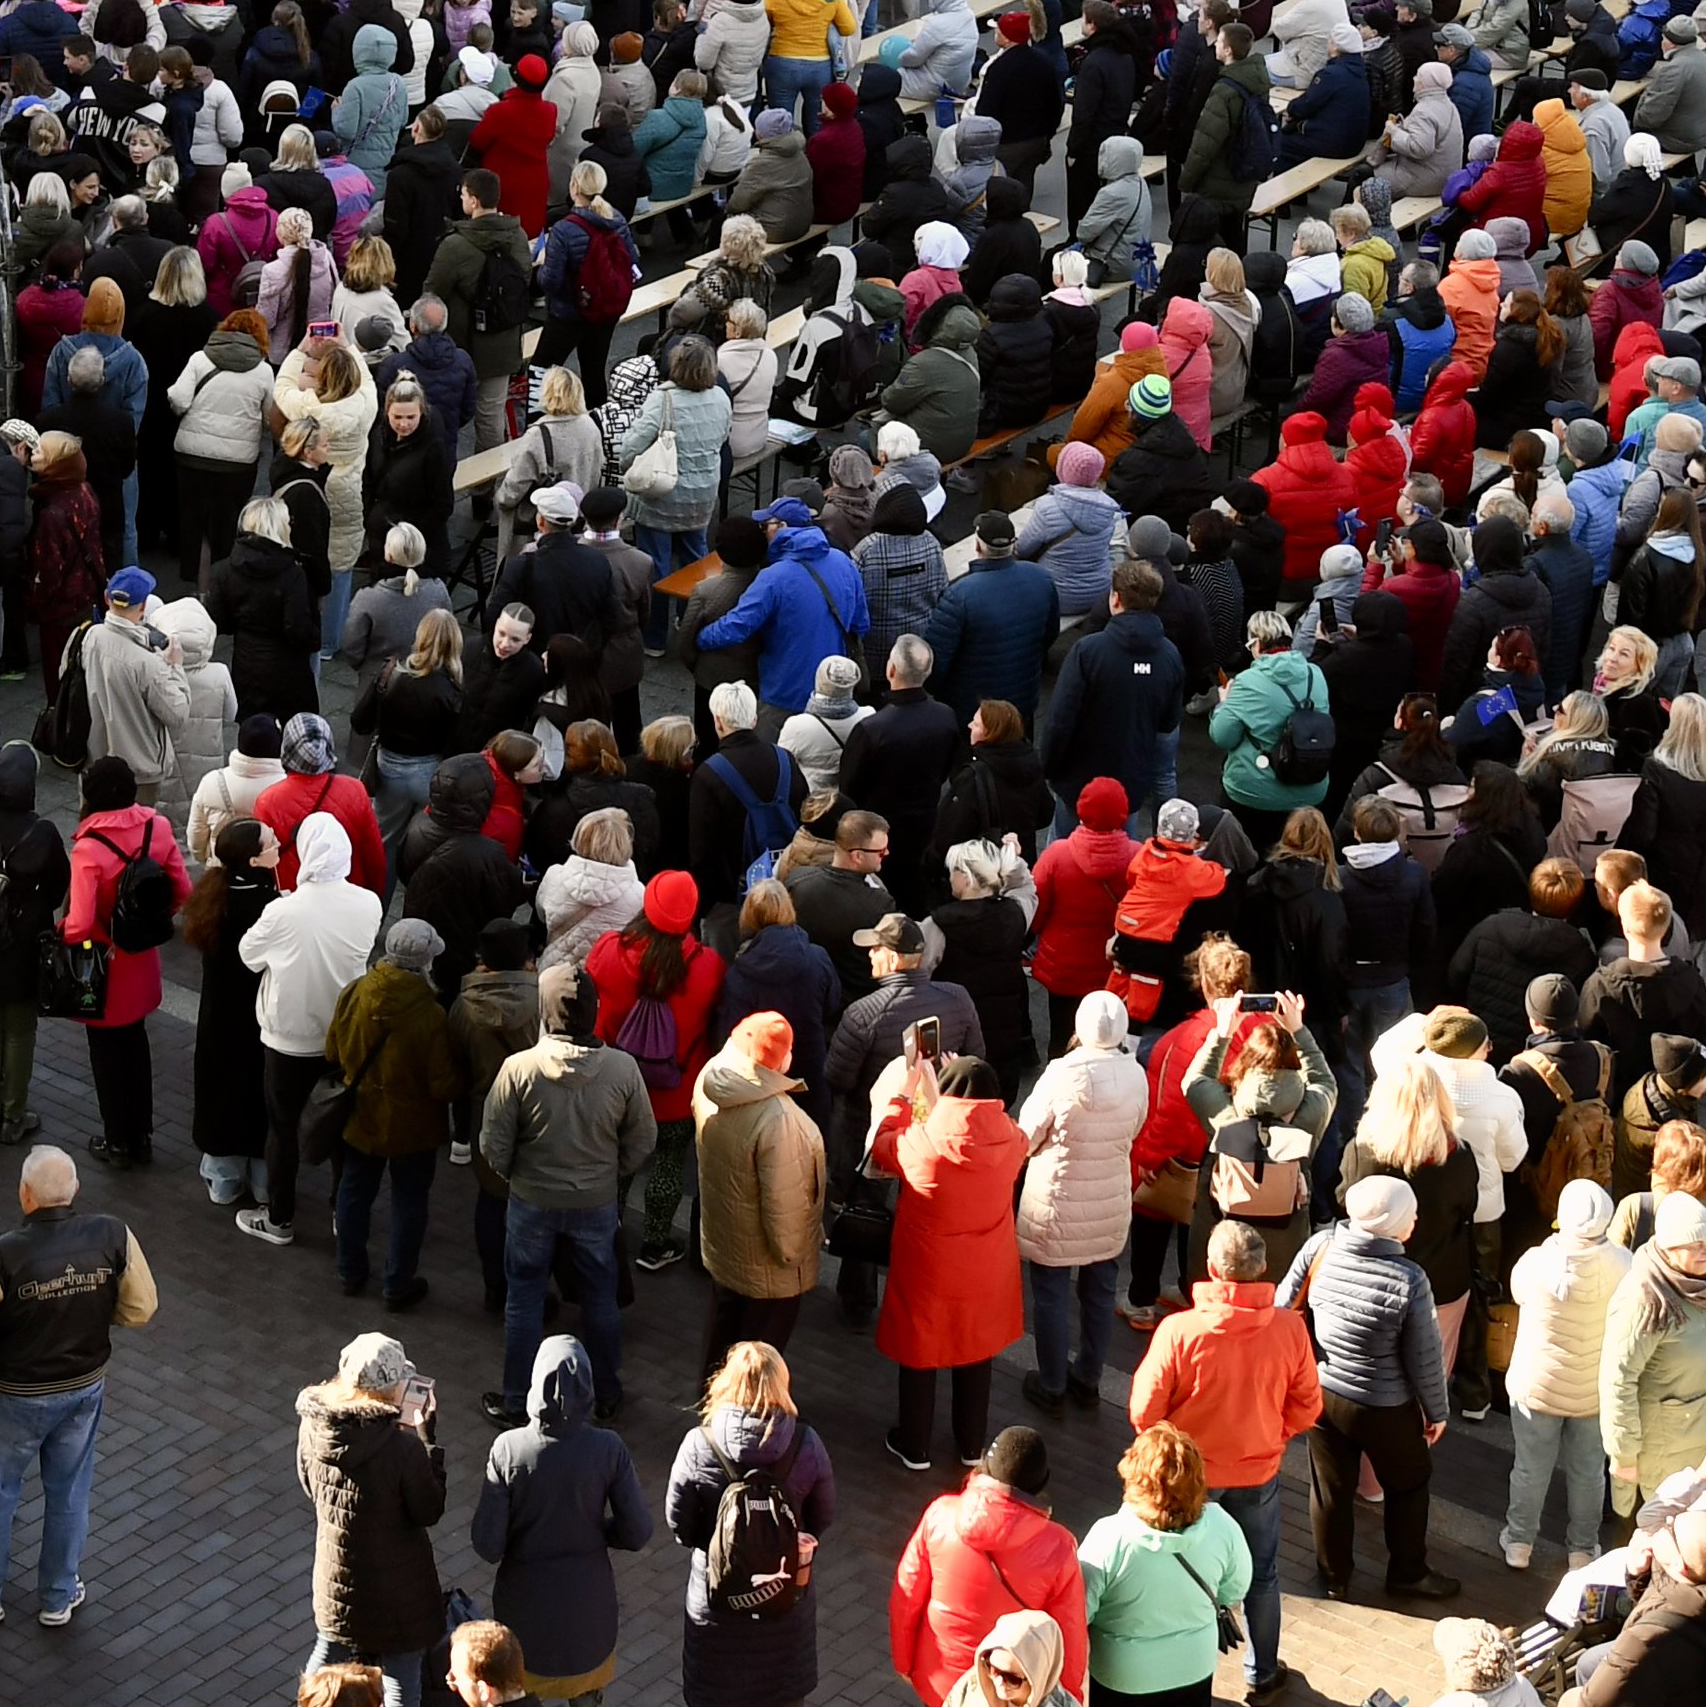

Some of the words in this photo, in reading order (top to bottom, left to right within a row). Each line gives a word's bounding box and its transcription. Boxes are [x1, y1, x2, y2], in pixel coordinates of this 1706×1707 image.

[77, 106, 112, 137] NEW
[112, 116, 138, 146] YO
[38, 1284, 97, 1300] COLLECTION
[727, 1578, 784, 1610] PUMA
